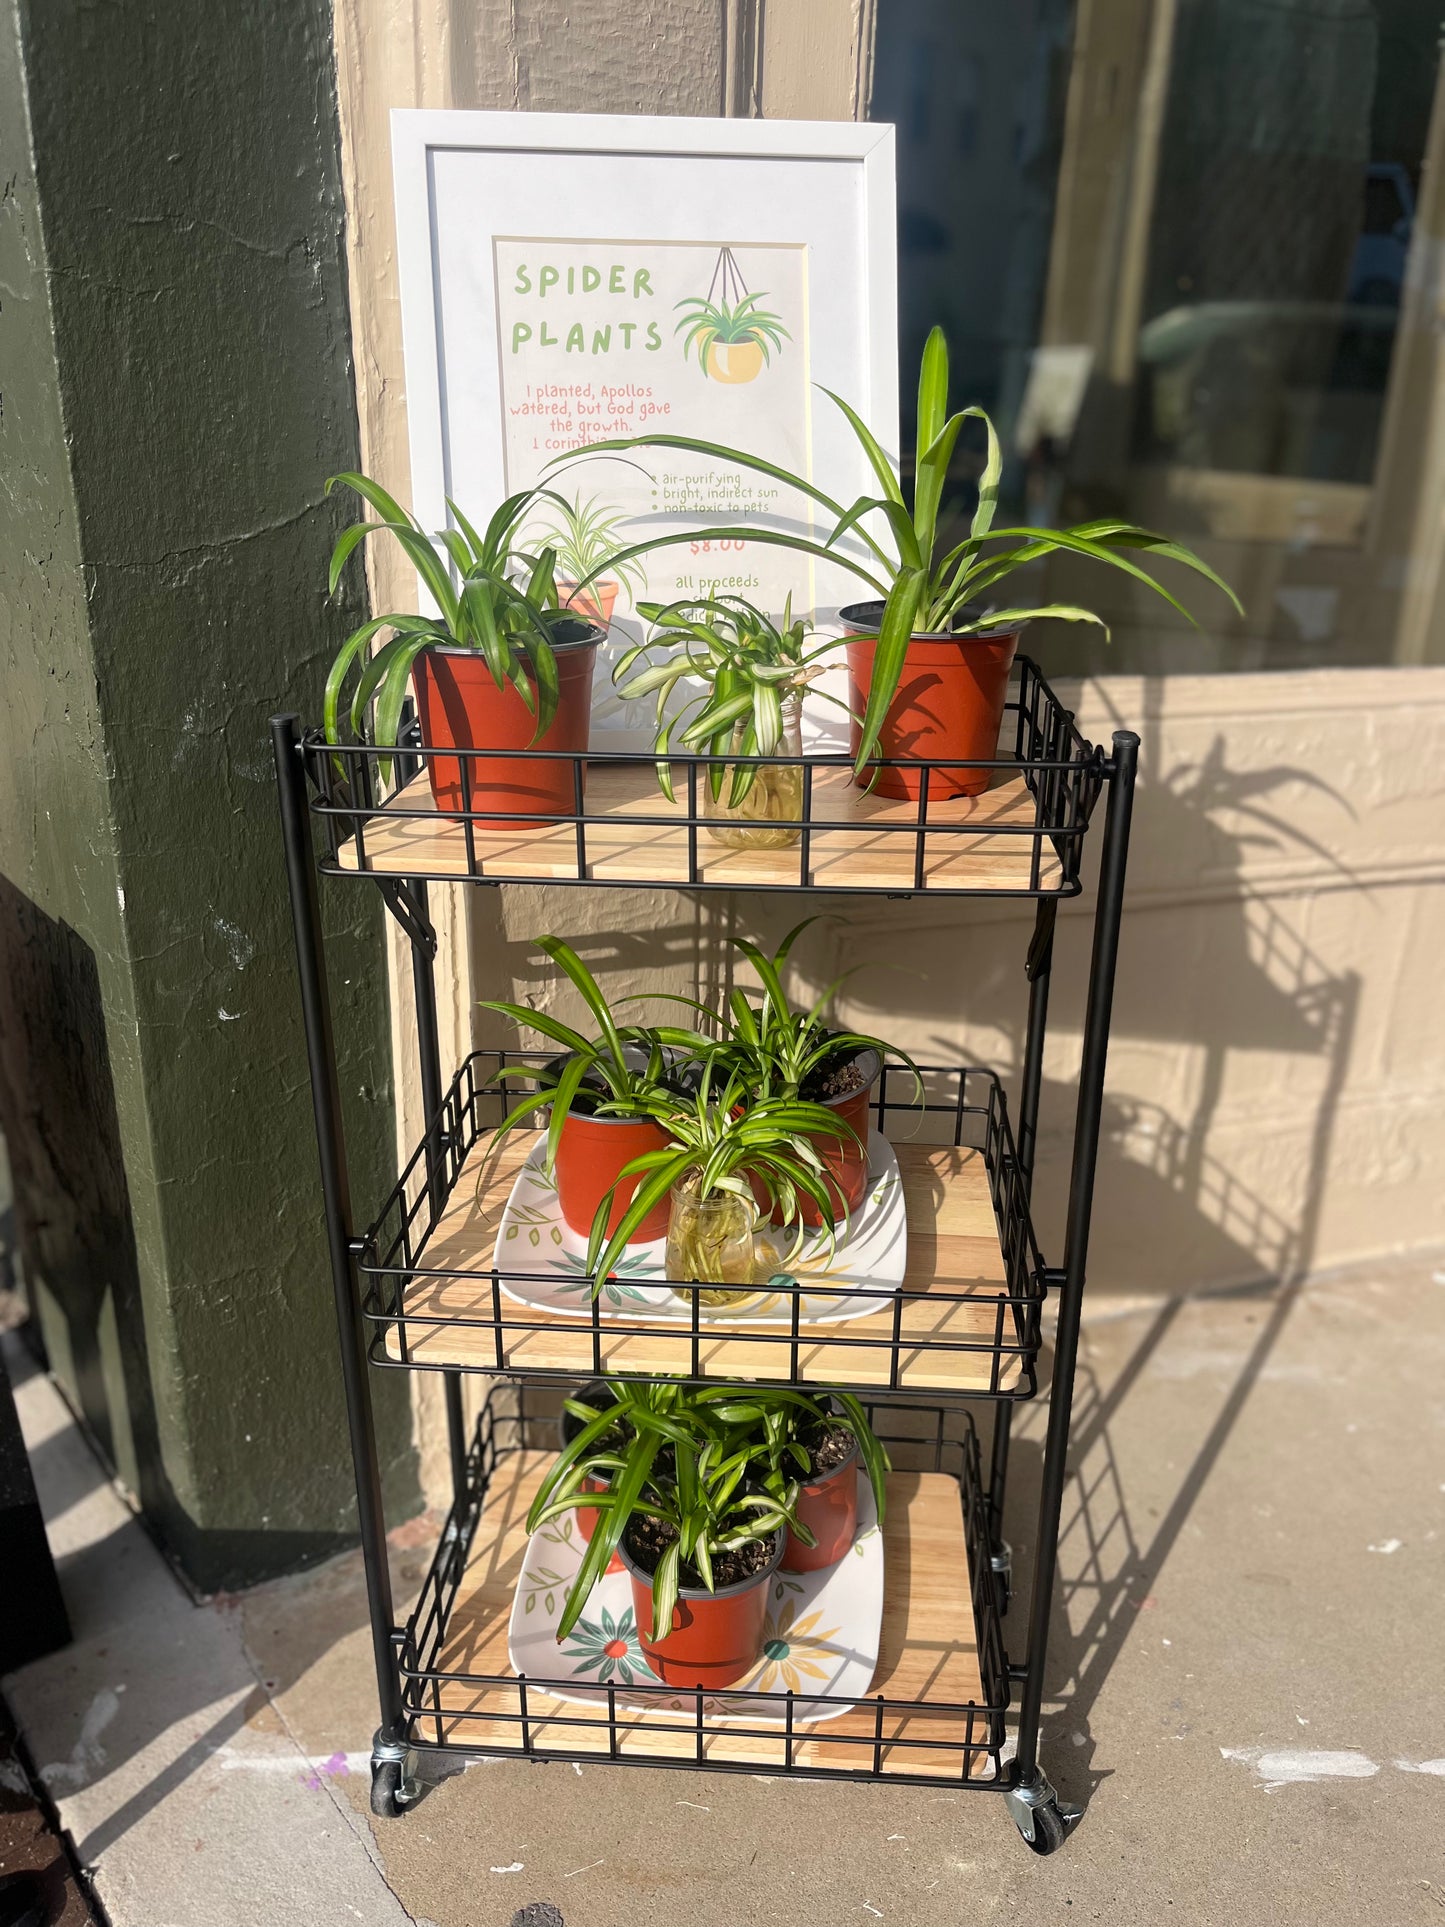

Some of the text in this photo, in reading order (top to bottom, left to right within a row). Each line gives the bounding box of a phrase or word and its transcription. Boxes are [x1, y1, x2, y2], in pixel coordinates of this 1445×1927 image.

[514, 264, 654, 299] SPIDER
[511, 321, 663, 355] PLANTS
[526, 383, 653, 403] I planted, Apollos
[510, 400, 671, 422] watered, but God gave
[550, 417, 633, 439] the growth.
[663, 471, 741, 490] air-purifying
[663, 486, 778, 505] bright, indirect sun
[664, 502, 769, 520] non-toxic to pets
[689, 539, 745, 556] $8.00
[675, 574, 759, 594] all proceeds
